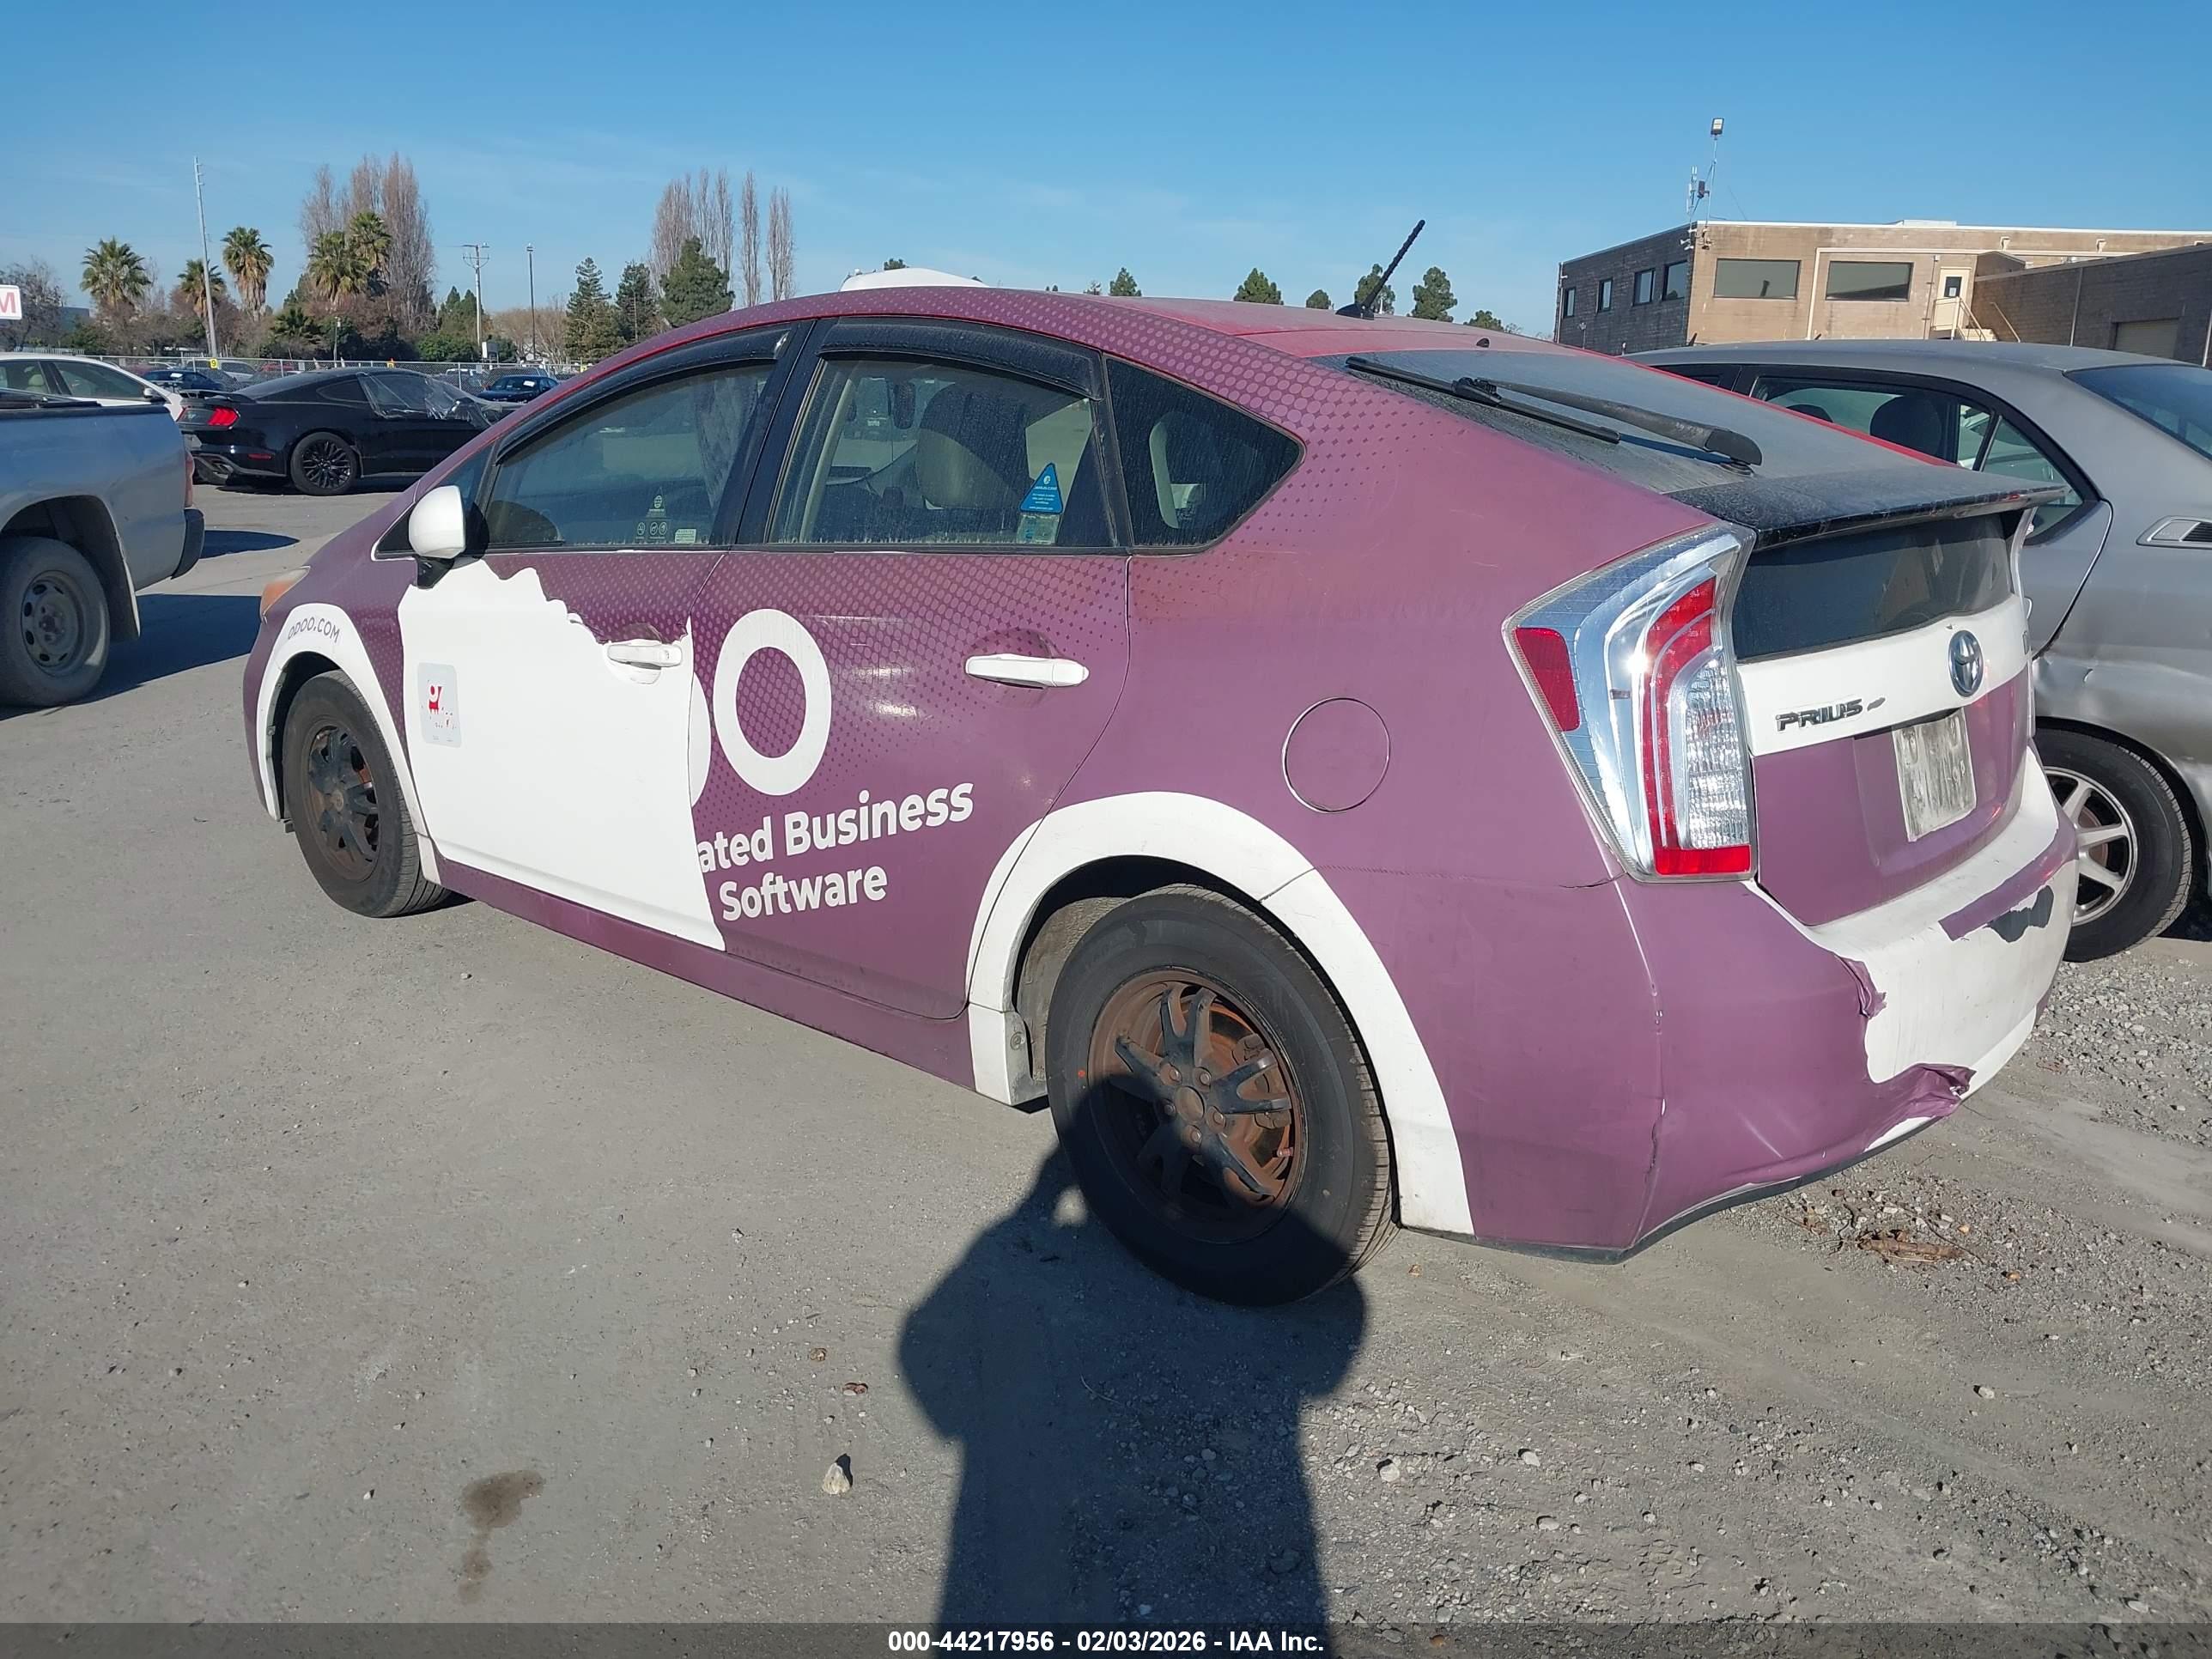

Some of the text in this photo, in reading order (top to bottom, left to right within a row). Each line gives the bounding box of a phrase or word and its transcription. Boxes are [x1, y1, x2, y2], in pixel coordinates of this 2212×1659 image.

[288, 617, 340, 644] ODOO.COM
[1776, 698, 1863, 732] PRIUS
[784, 782, 974, 857] Business
[719, 866, 888, 921] Software
